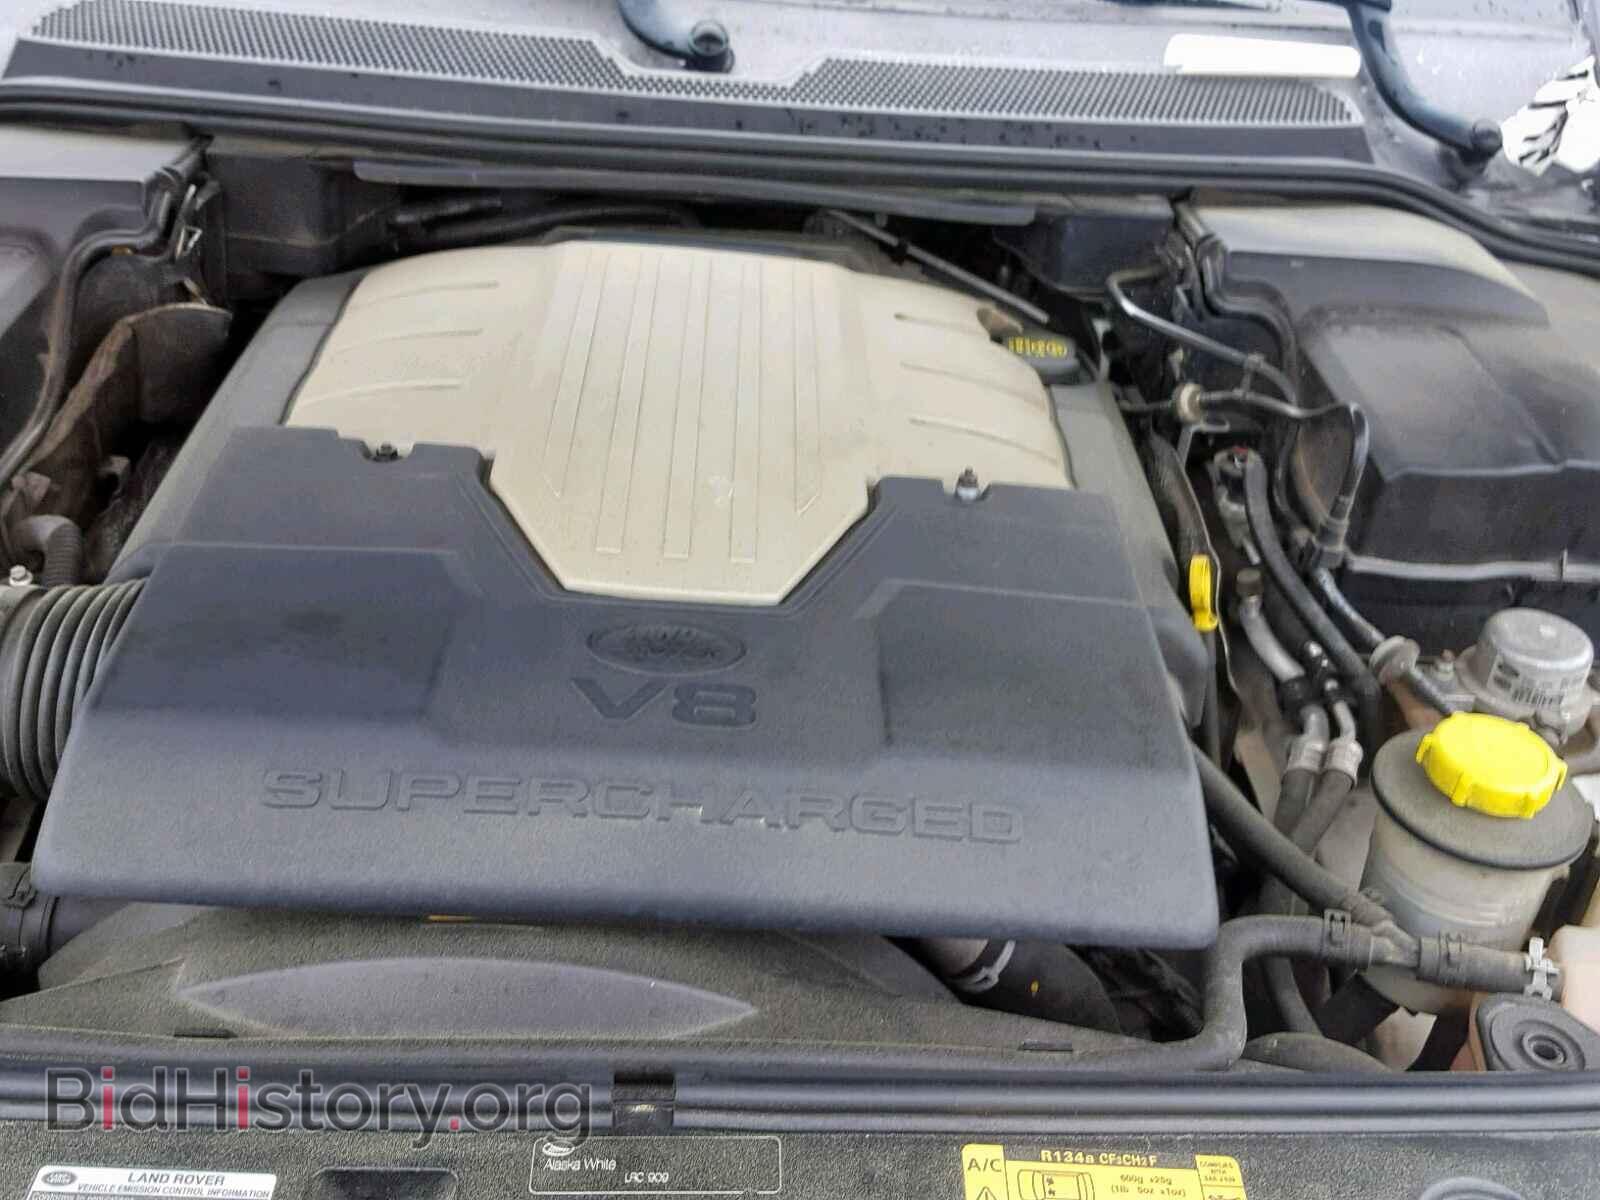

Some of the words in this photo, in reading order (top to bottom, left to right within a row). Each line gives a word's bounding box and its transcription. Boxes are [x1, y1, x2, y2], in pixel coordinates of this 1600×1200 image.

[571, 676, 758, 727] V8
[262, 767, 1024, 845] SUPERCHARGED
[1040, 1149, 1095, 1164] R134a
[543, 1158, 581, 1172] Alaska
[584, 1158, 617, 1171] White
[967, 1158, 1002, 1173] A/C
[127, 1171, 170, 1185] LAND
[173, 1173, 226, 1186] ROVER
[78, 1183, 114, 1193] VEHICLE
[117, 1184, 160, 1194] EMISSION
[162, 1186, 204, 1196] CONTROL
[207, 1188, 271, 1198] INFORMATION
